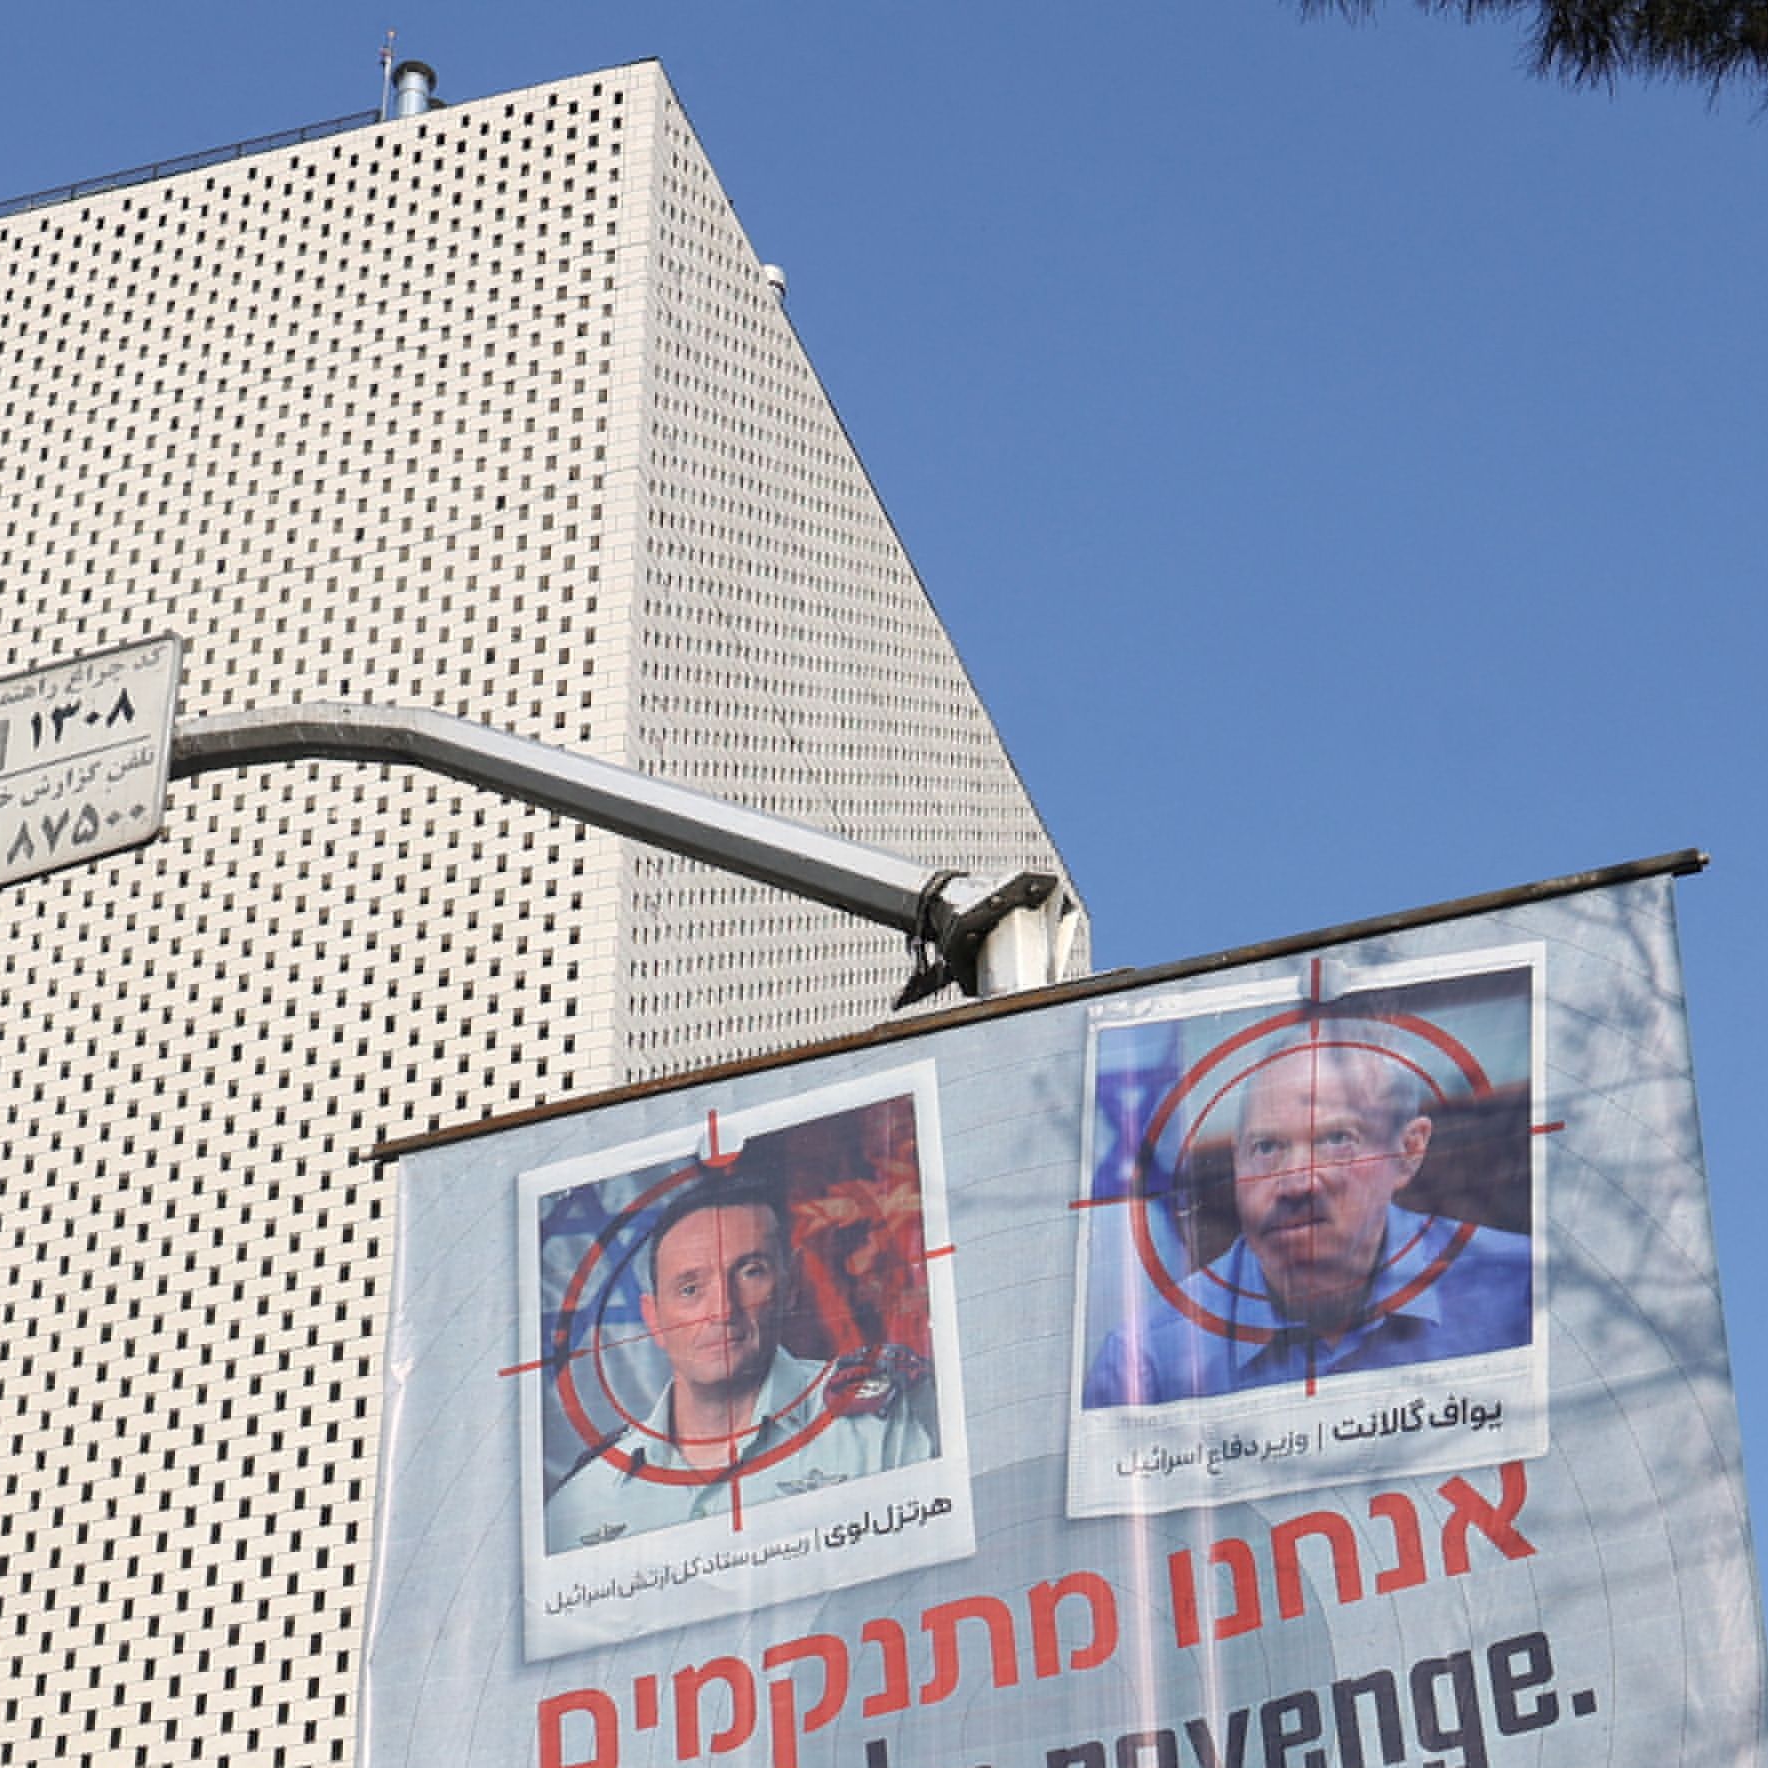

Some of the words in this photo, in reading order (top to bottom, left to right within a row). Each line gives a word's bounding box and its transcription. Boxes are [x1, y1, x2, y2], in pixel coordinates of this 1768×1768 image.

[7, 803, 145, 866] ۸۷۵۰۰
[1333, 1400, 1425, 1442] گالانت
[1429, 1393, 1503, 1432] یواف
[1116, 1447, 1201, 1478] اسرائیل
[1207, 1439, 1259, 1476] دفاع
[1264, 1431, 1310, 1463] وزیر
[823, 1512, 870, 1549] لوی
[872, 1496, 952, 1536] هرتزل
[671, 1557, 702, 1587] کل
[702, 1550, 750, 1576] ستاد
[1163, 1460, 1537, 1651] אנחנו
[544, 1578, 617, 1615] اسرائیل
[618, 1567, 671, 1599] ارتش
